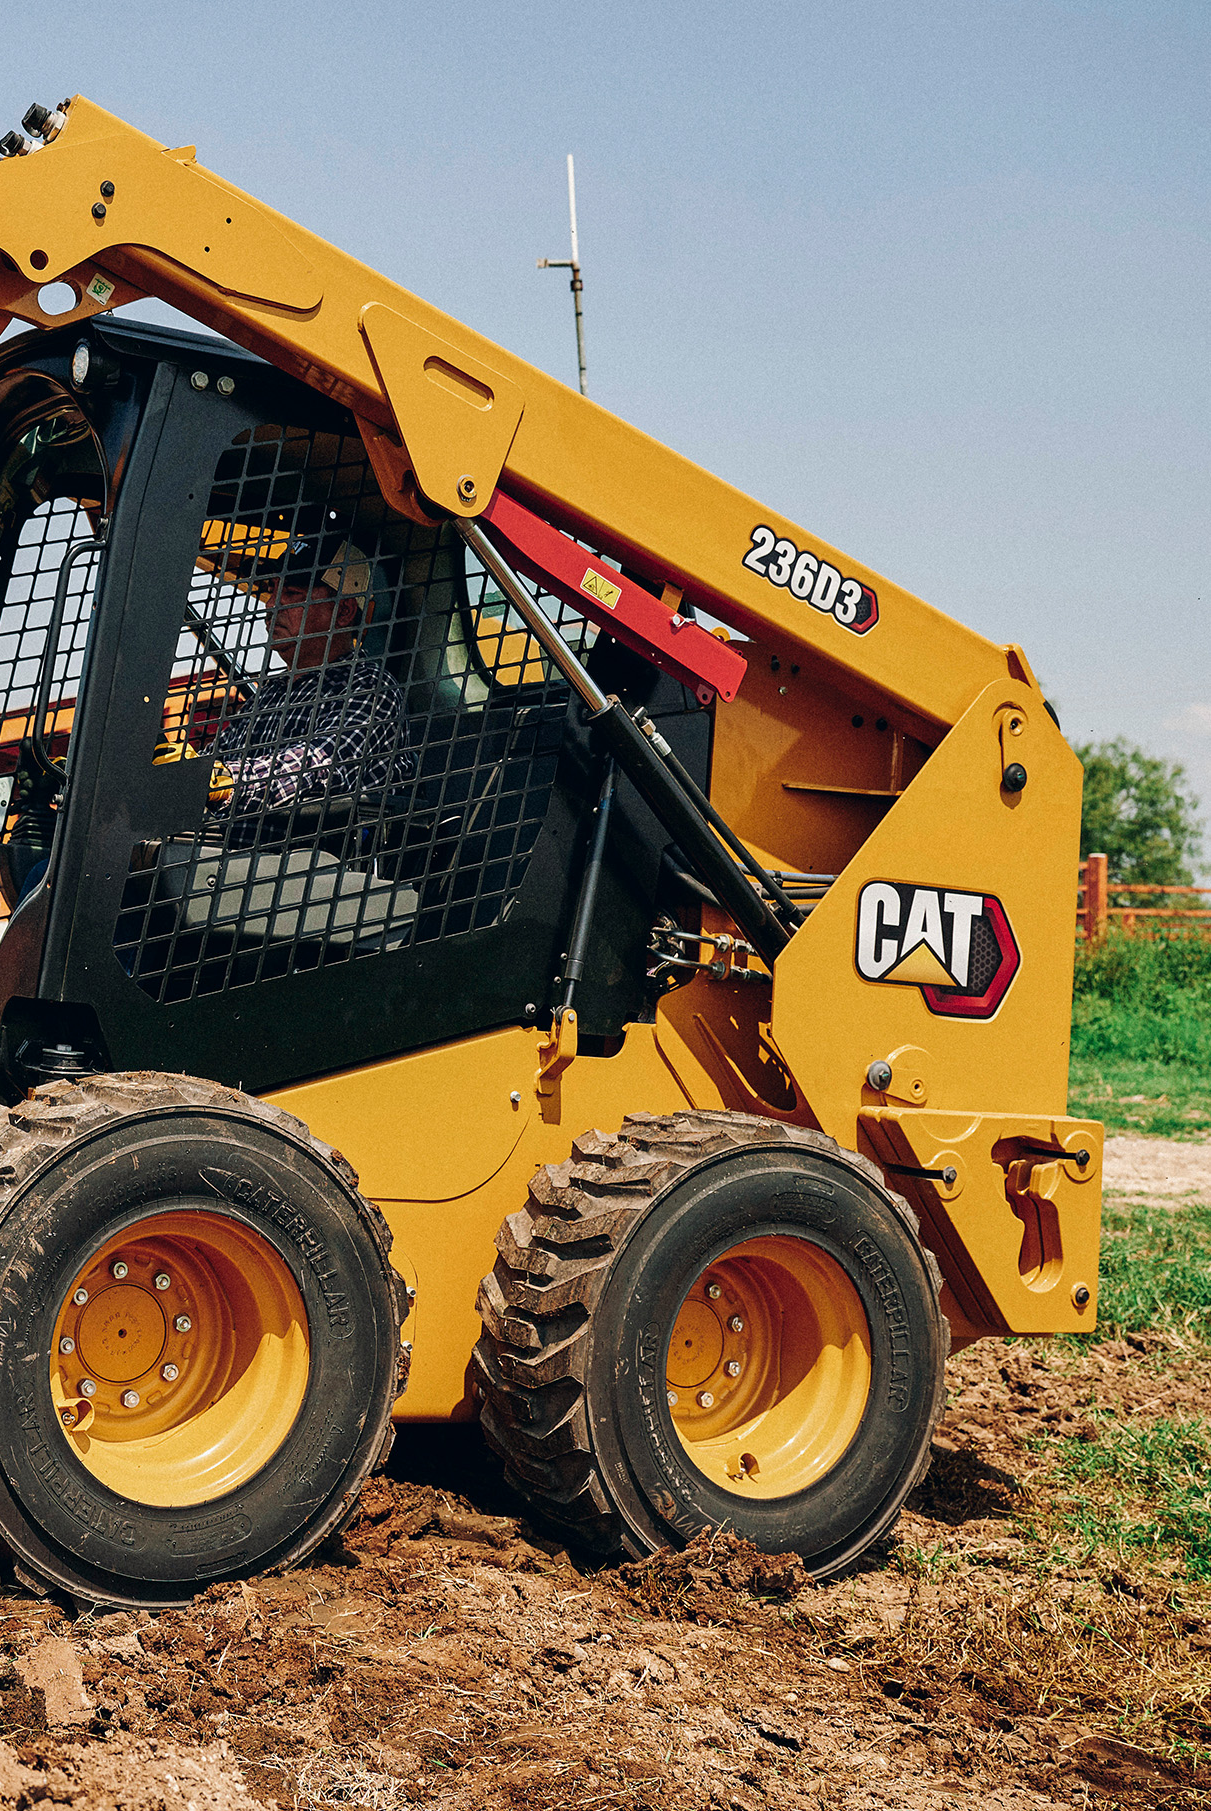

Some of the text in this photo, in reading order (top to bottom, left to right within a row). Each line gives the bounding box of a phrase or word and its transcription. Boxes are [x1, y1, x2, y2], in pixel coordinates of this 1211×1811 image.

[743, 526, 864, 625] 236D3
[858, 882, 984, 988] CAT
[233, 1177, 349, 1328] CATERPILLAR
